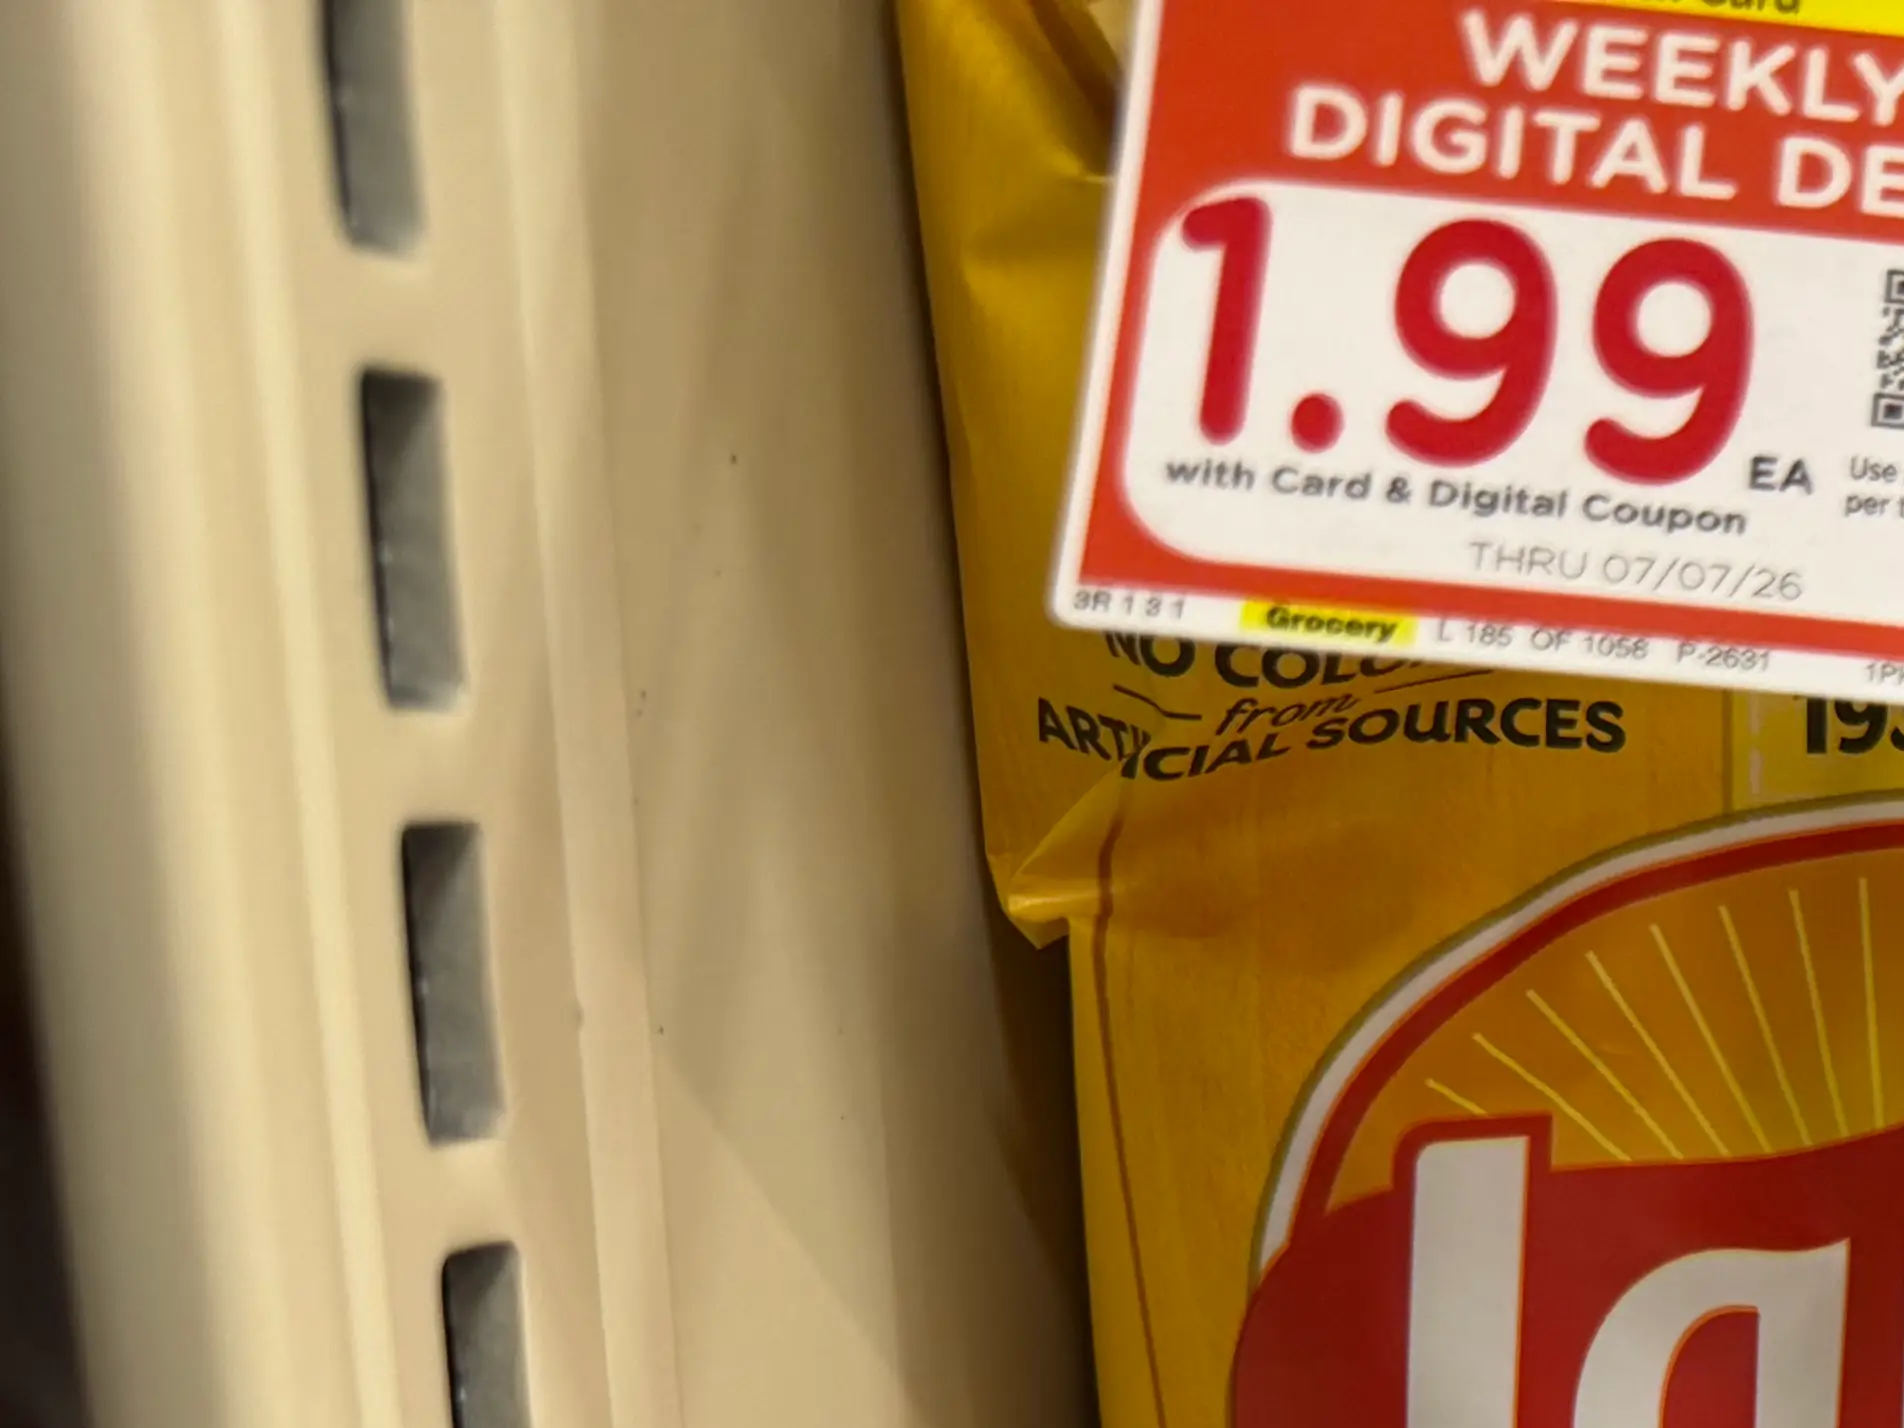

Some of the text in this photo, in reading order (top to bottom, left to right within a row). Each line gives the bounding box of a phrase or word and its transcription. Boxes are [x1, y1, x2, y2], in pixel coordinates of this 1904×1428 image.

[1288, 83, 1737, 201] DIGITAL
[1182, 194, 1757, 487] 1.99
[1748, 455, 1815, 496] EA
[1848, 456, 1898, 483] Use
[1165, 457, 1748, 535] with Card & Digital Coupon
[1843, 494, 1891, 517] per
[1469, 540, 1804, 601] THRU 07/07/26
[1266, 605, 1398, 641] Grocery
[1529, 627, 1573, 651] OF
[1216, 694, 1362, 737] from
[1306, 696, 1627, 754] SOURCES
